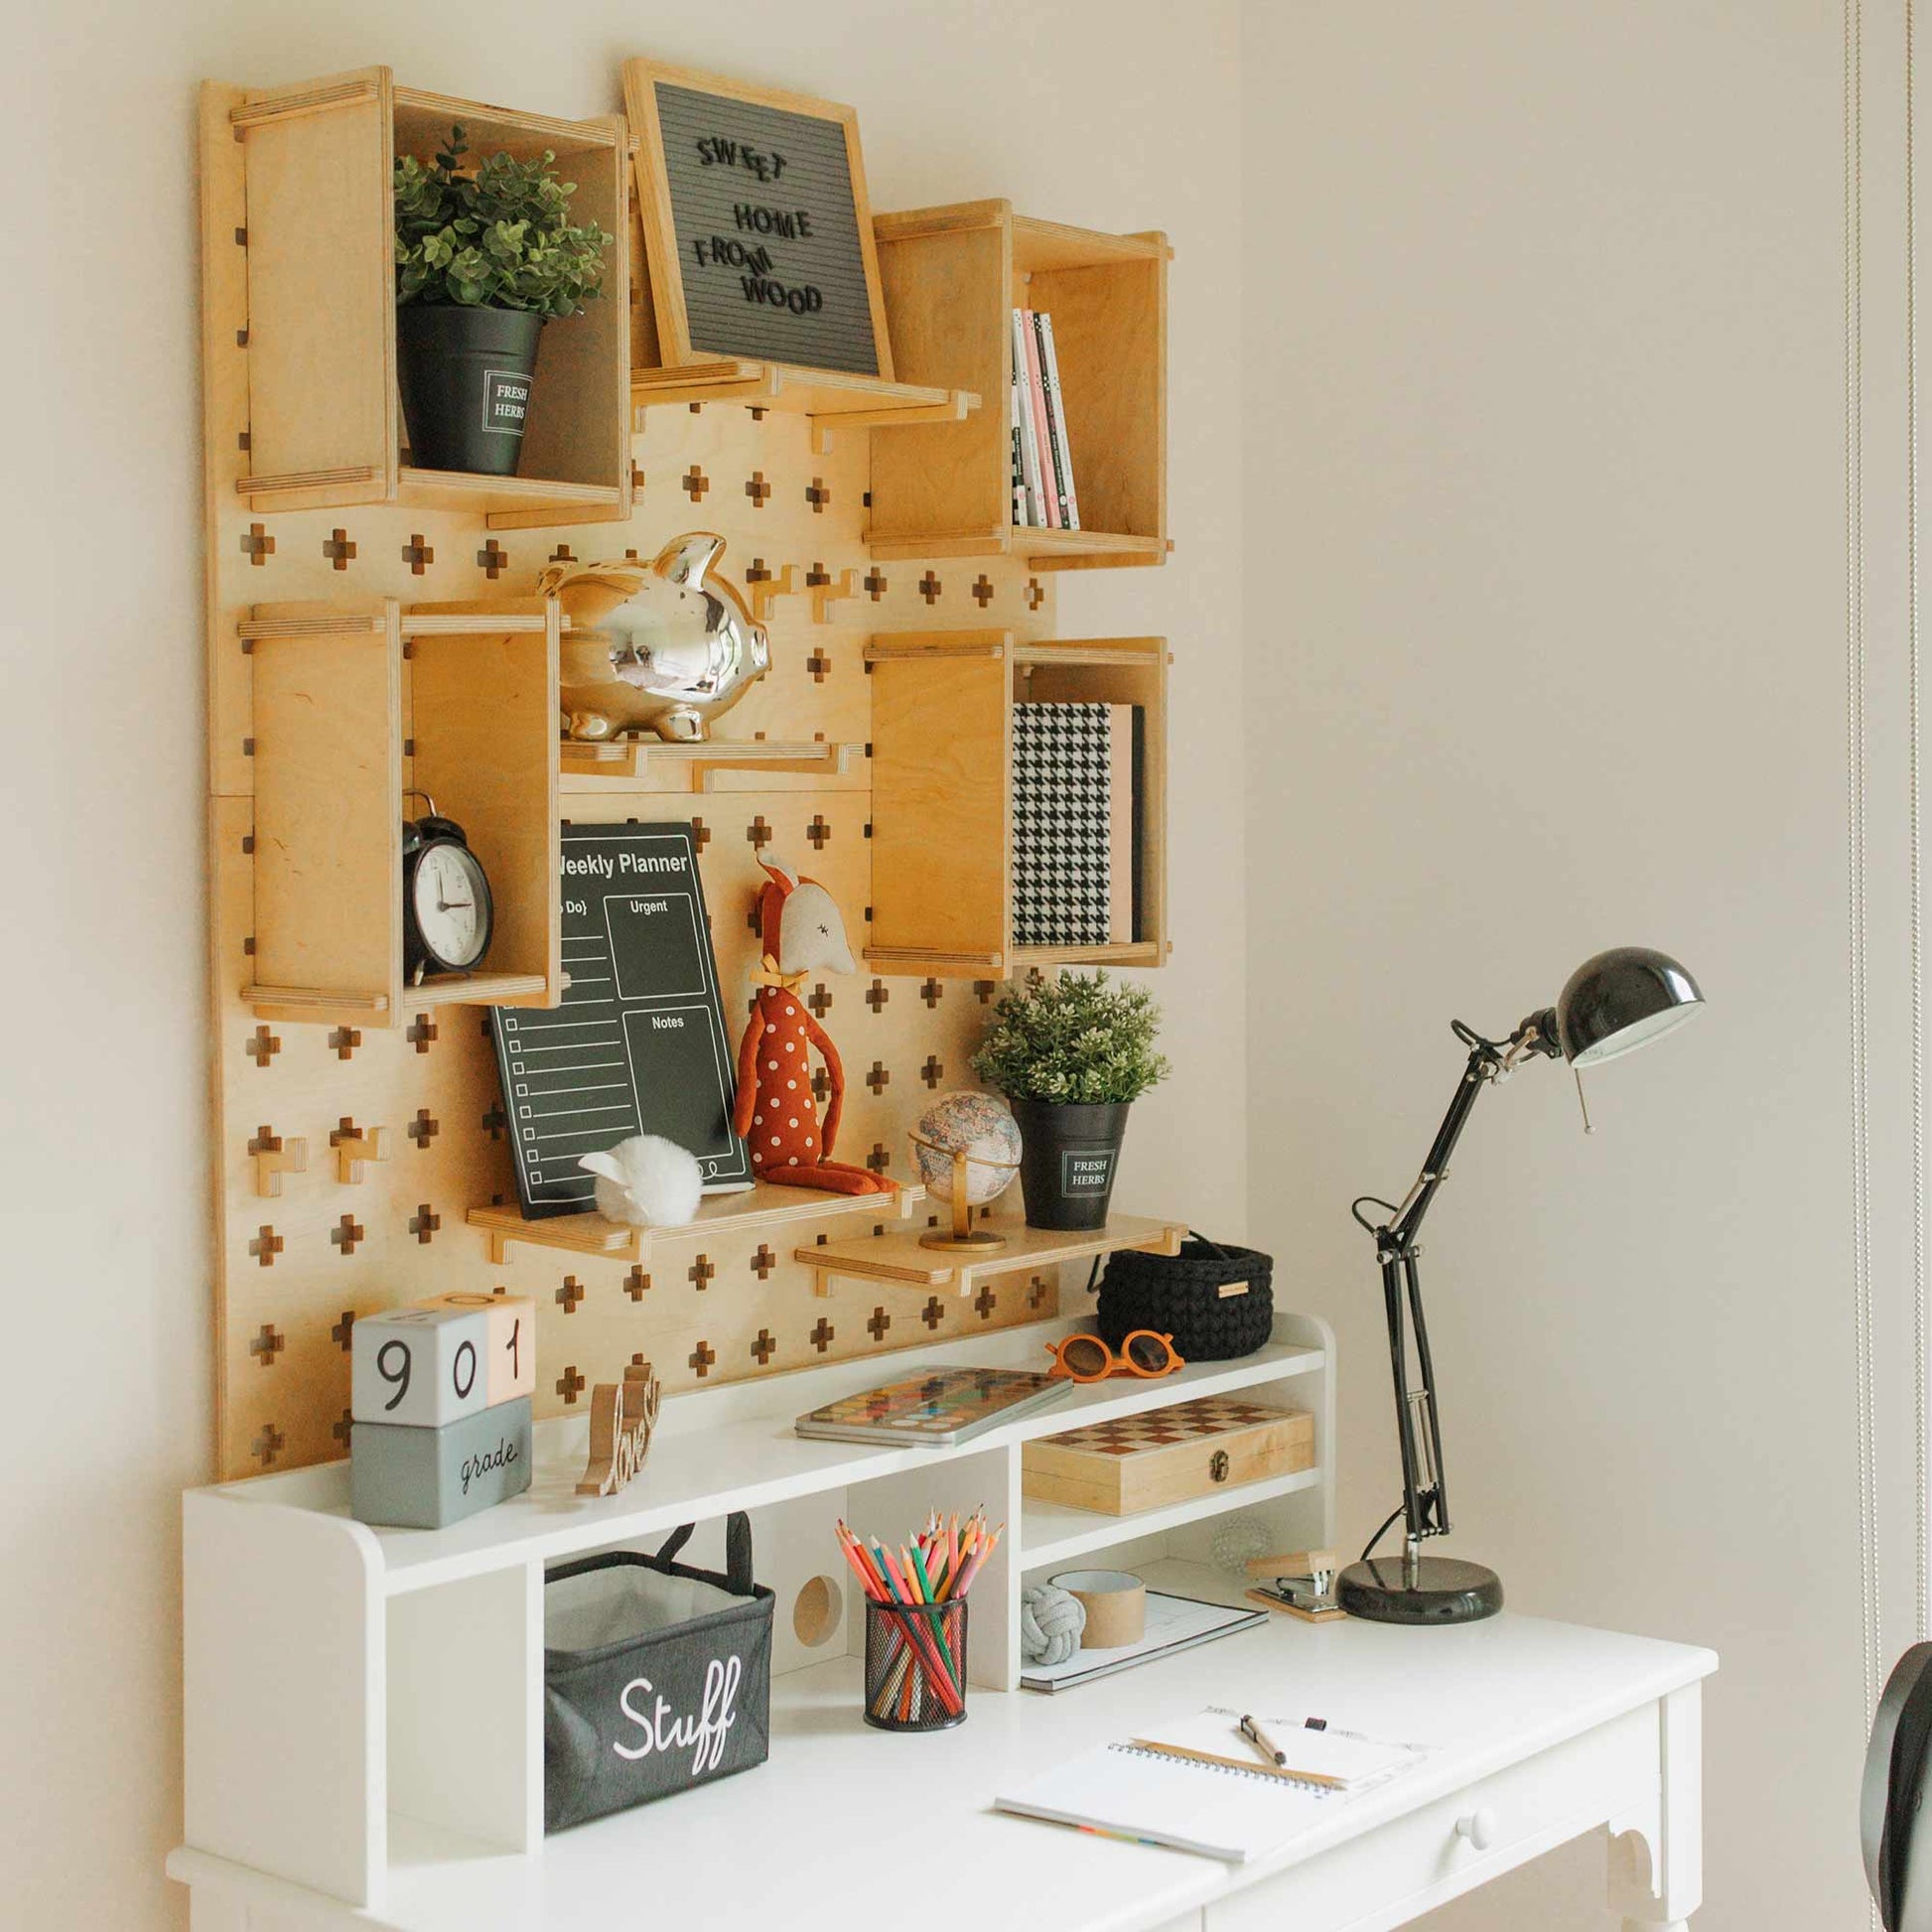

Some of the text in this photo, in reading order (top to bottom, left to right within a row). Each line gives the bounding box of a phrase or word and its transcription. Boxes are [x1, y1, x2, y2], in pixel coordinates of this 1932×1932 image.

[697, 137, 787, 183] SWEET
[735, 203, 813, 239] HOME
[695, 235, 773, 277] FROM
[741, 276, 823, 315] WOOD
[496, 384, 528, 401] FRESH
[494, 403, 525, 419] HERBS
[618, 853, 688, 874] Planner
[629, 899, 668, 915] Urgent
[651, 1016, 685, 1030] Notes
[1073, 1160, 1107, 1172] FRESH
[1072, 1173, 1105, 1185] HERBS
[461, 1437, 518, 1495] grade
[613, 1655, 742, 1776] Stuff
